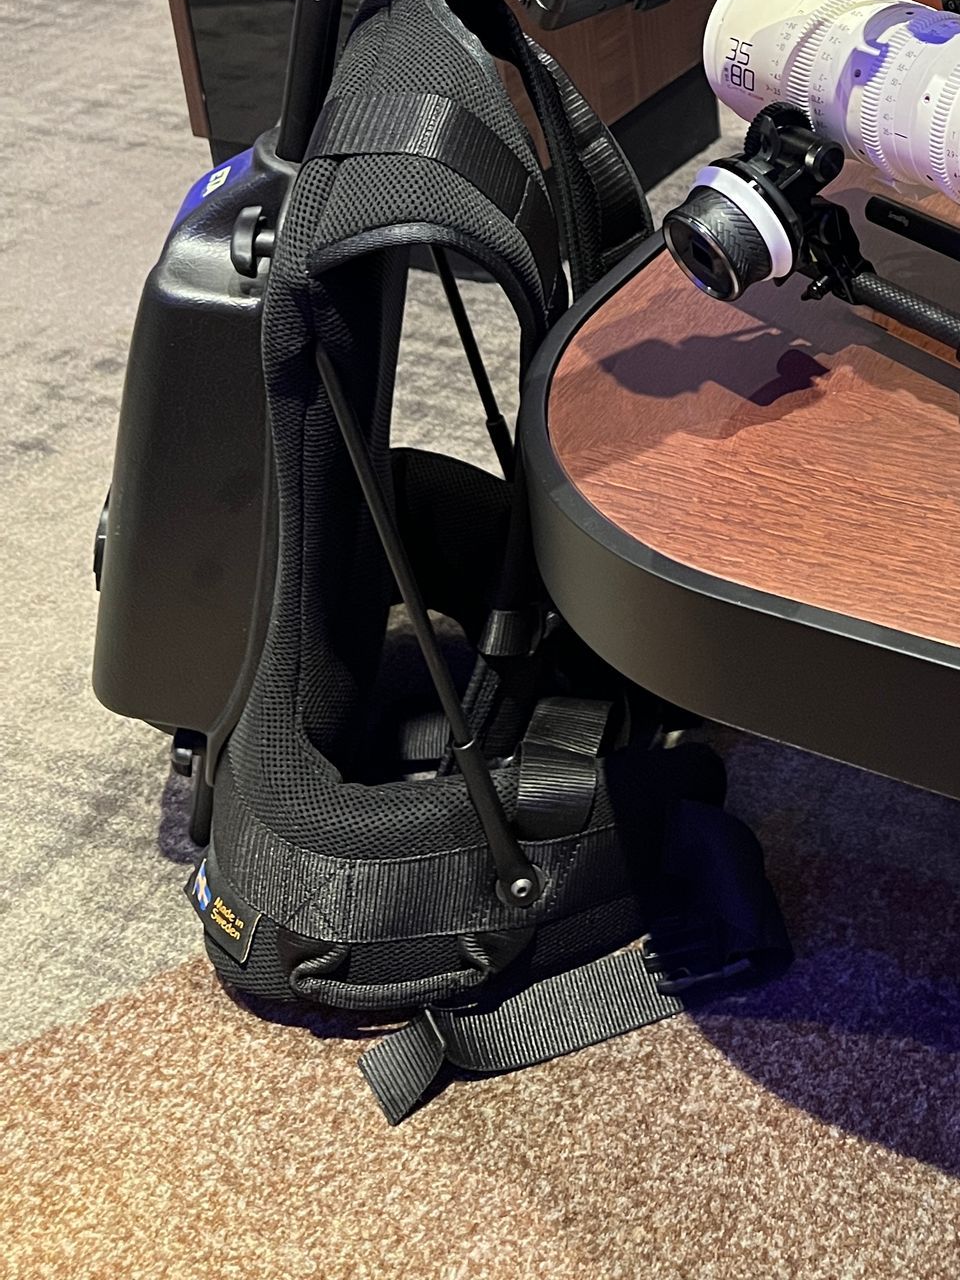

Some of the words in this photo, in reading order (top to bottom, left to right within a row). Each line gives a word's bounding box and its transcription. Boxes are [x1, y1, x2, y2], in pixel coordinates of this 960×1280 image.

[725, 37, 753, 66] 35
[730, 64, 755, 91] 80
[211, 907, 241, 940] Sweden
[213, 896, 236, 922] Made
[235, 917, 244, 929] in
